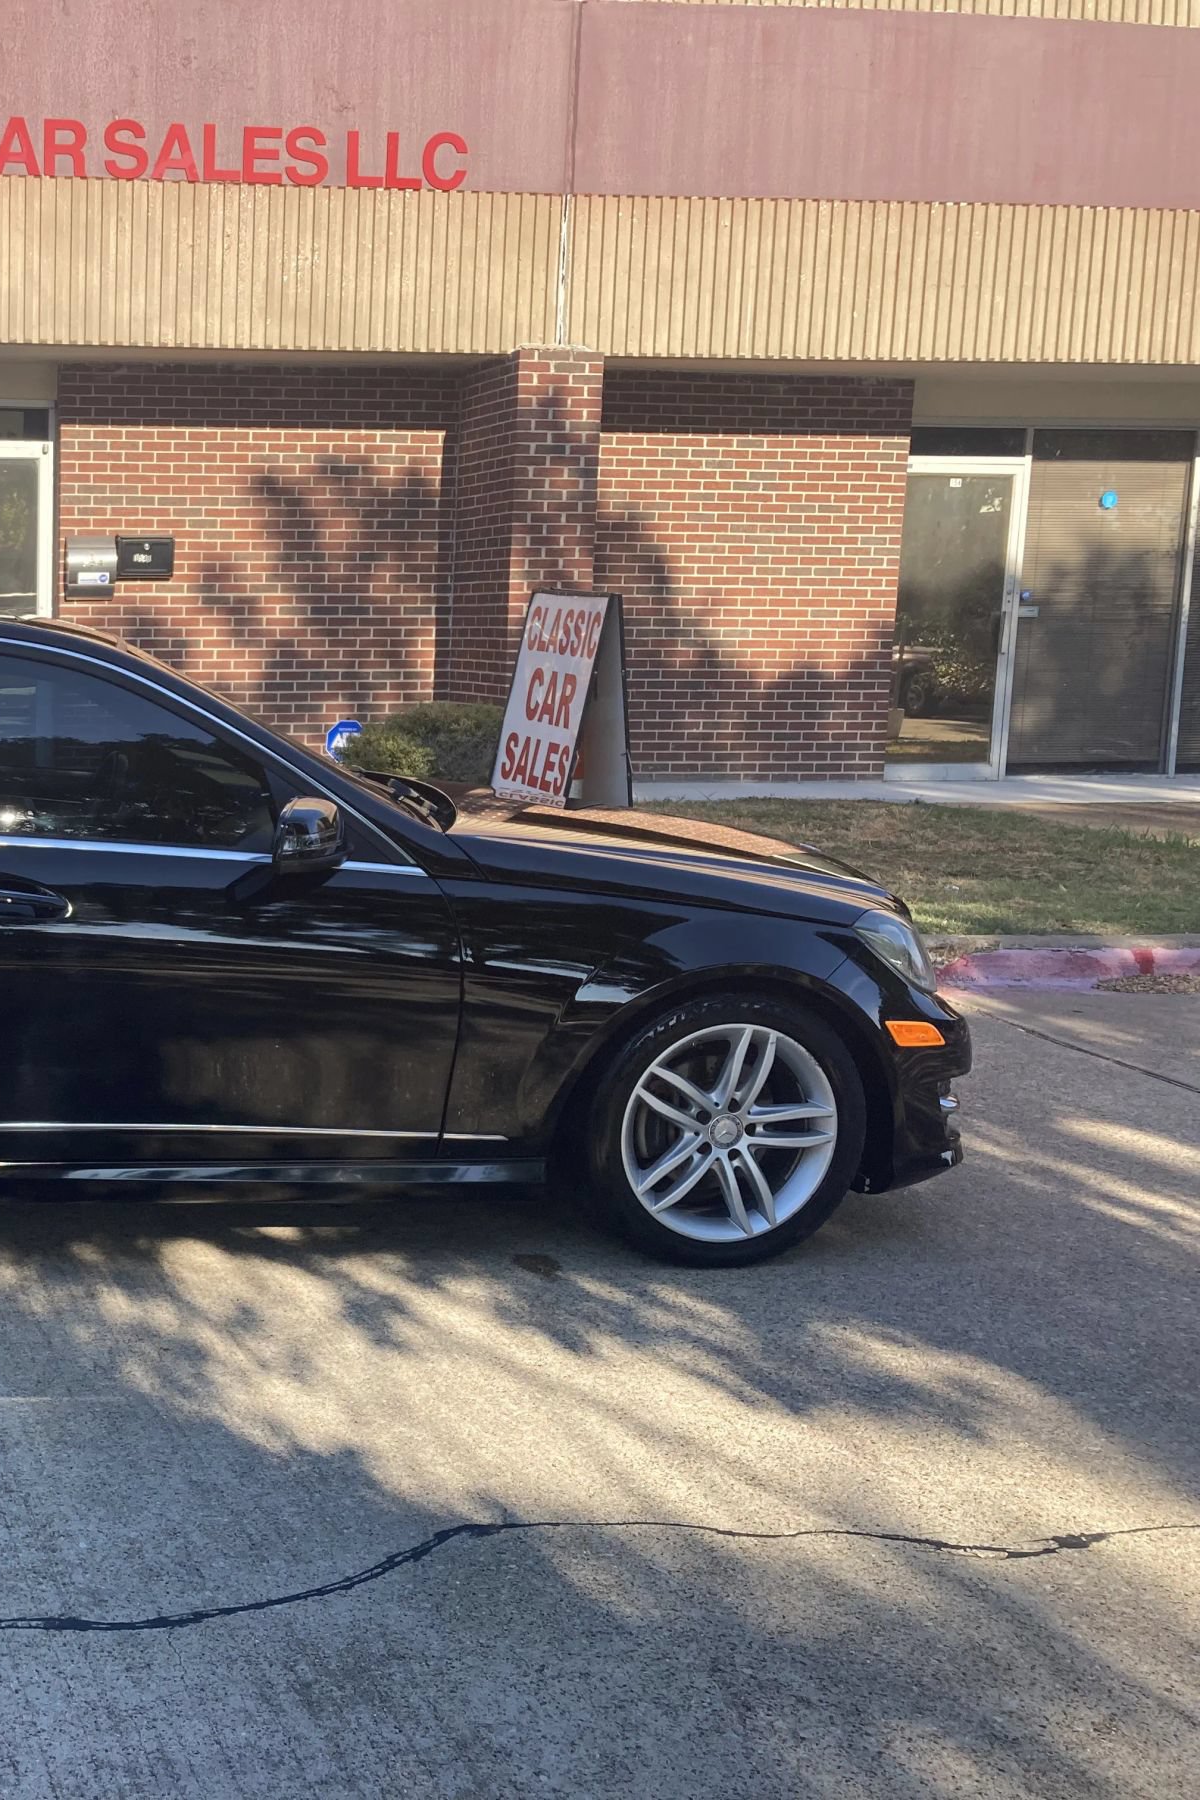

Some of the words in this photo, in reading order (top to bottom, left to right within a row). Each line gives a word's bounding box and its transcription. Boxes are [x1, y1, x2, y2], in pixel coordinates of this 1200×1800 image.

[103, 119, 330, 187] SALES
[346, 129, 470, 193] LLC
[527, 605, 603, 660] CLASSIC
[525, 667, 577, 729] CAR
[501, 732, 570, 797] SALES
